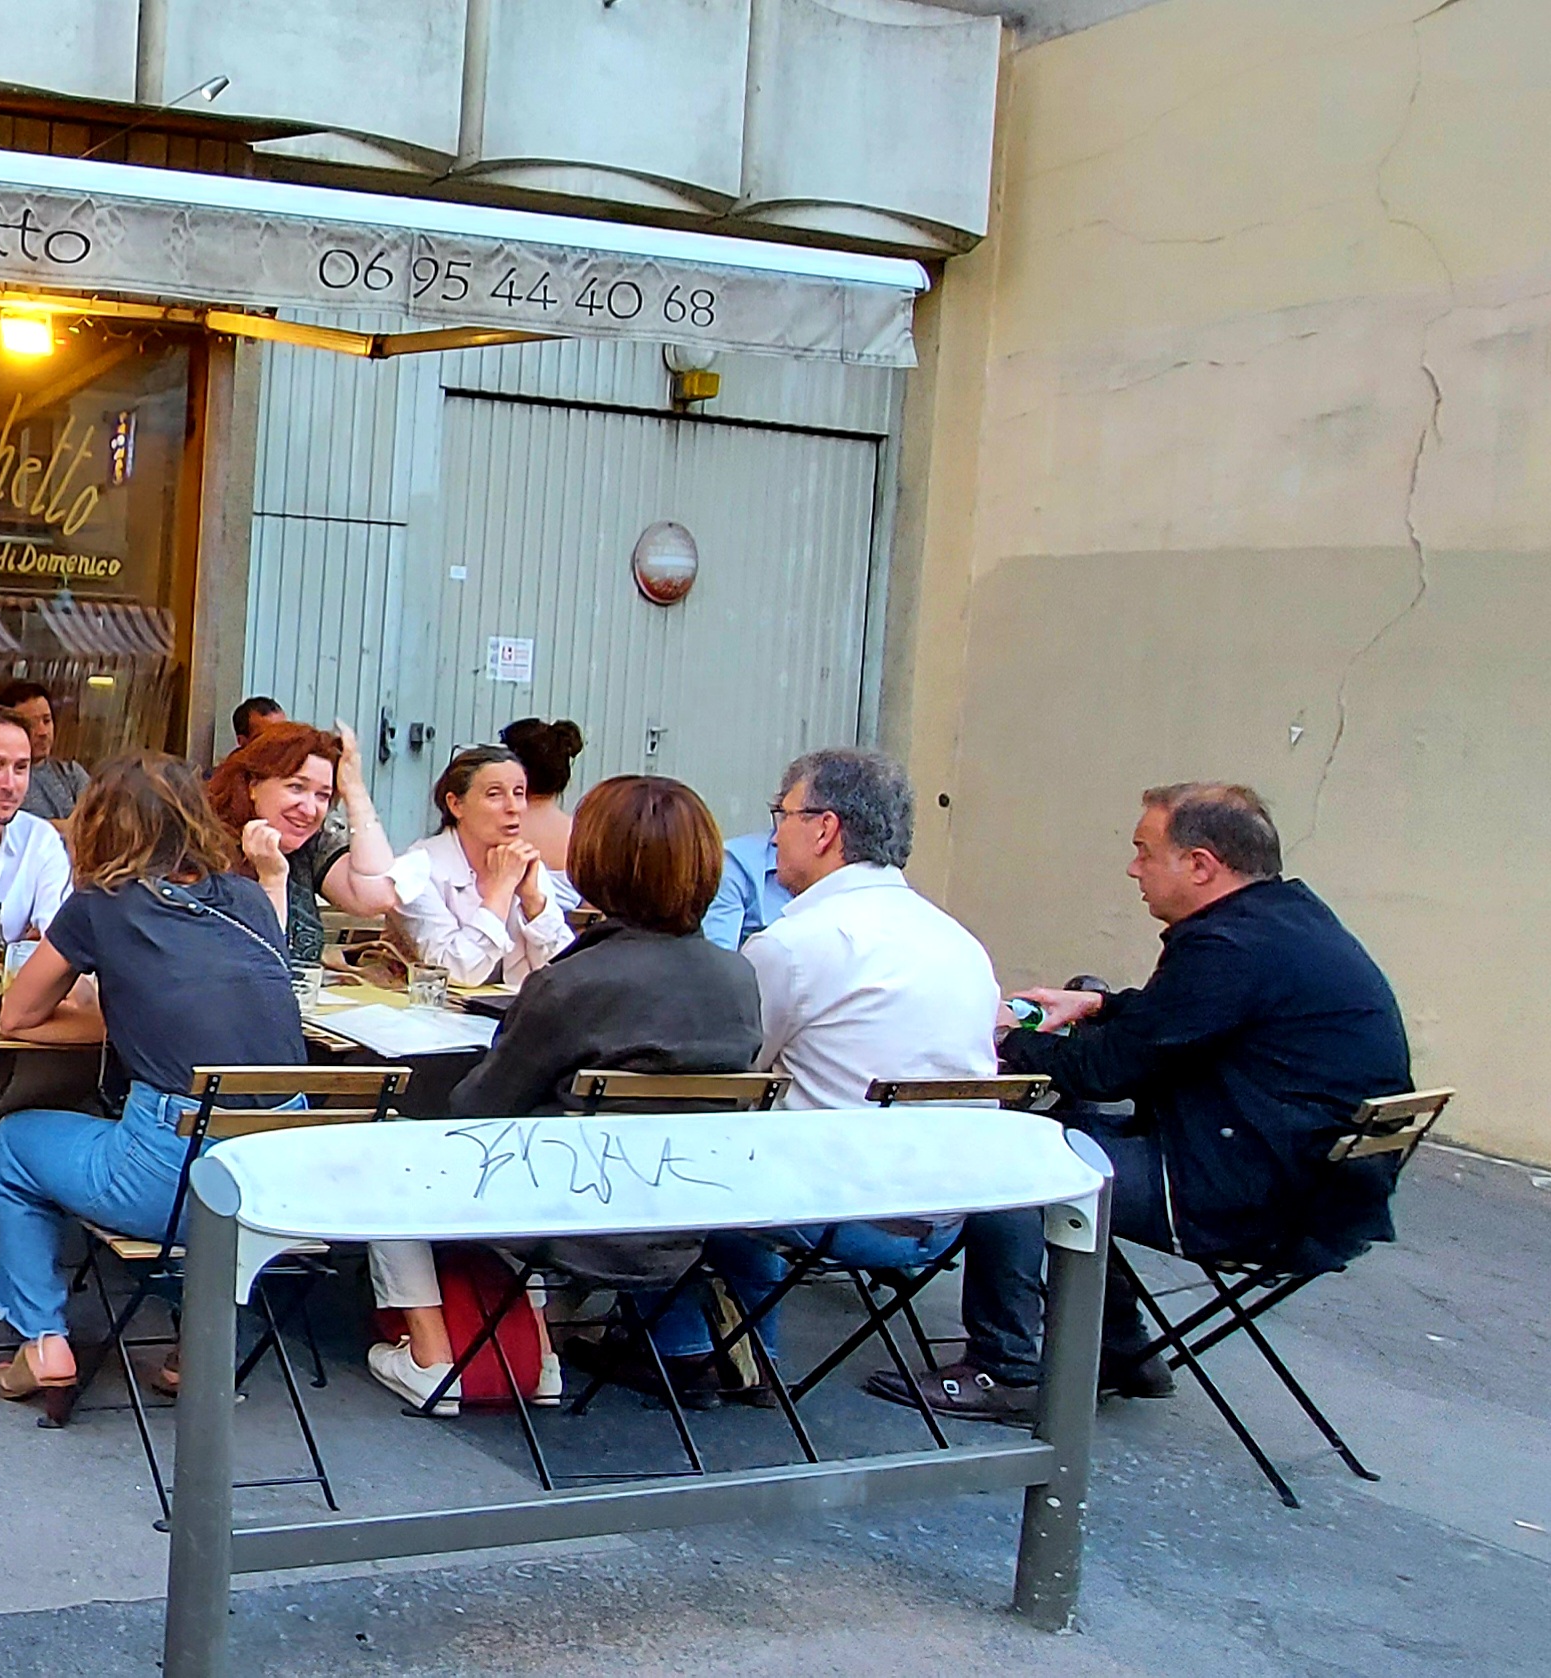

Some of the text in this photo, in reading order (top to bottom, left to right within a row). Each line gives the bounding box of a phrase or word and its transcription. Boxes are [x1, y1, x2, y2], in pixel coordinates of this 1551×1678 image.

[318, 248, 716, 328] 06 95 44 40 68
